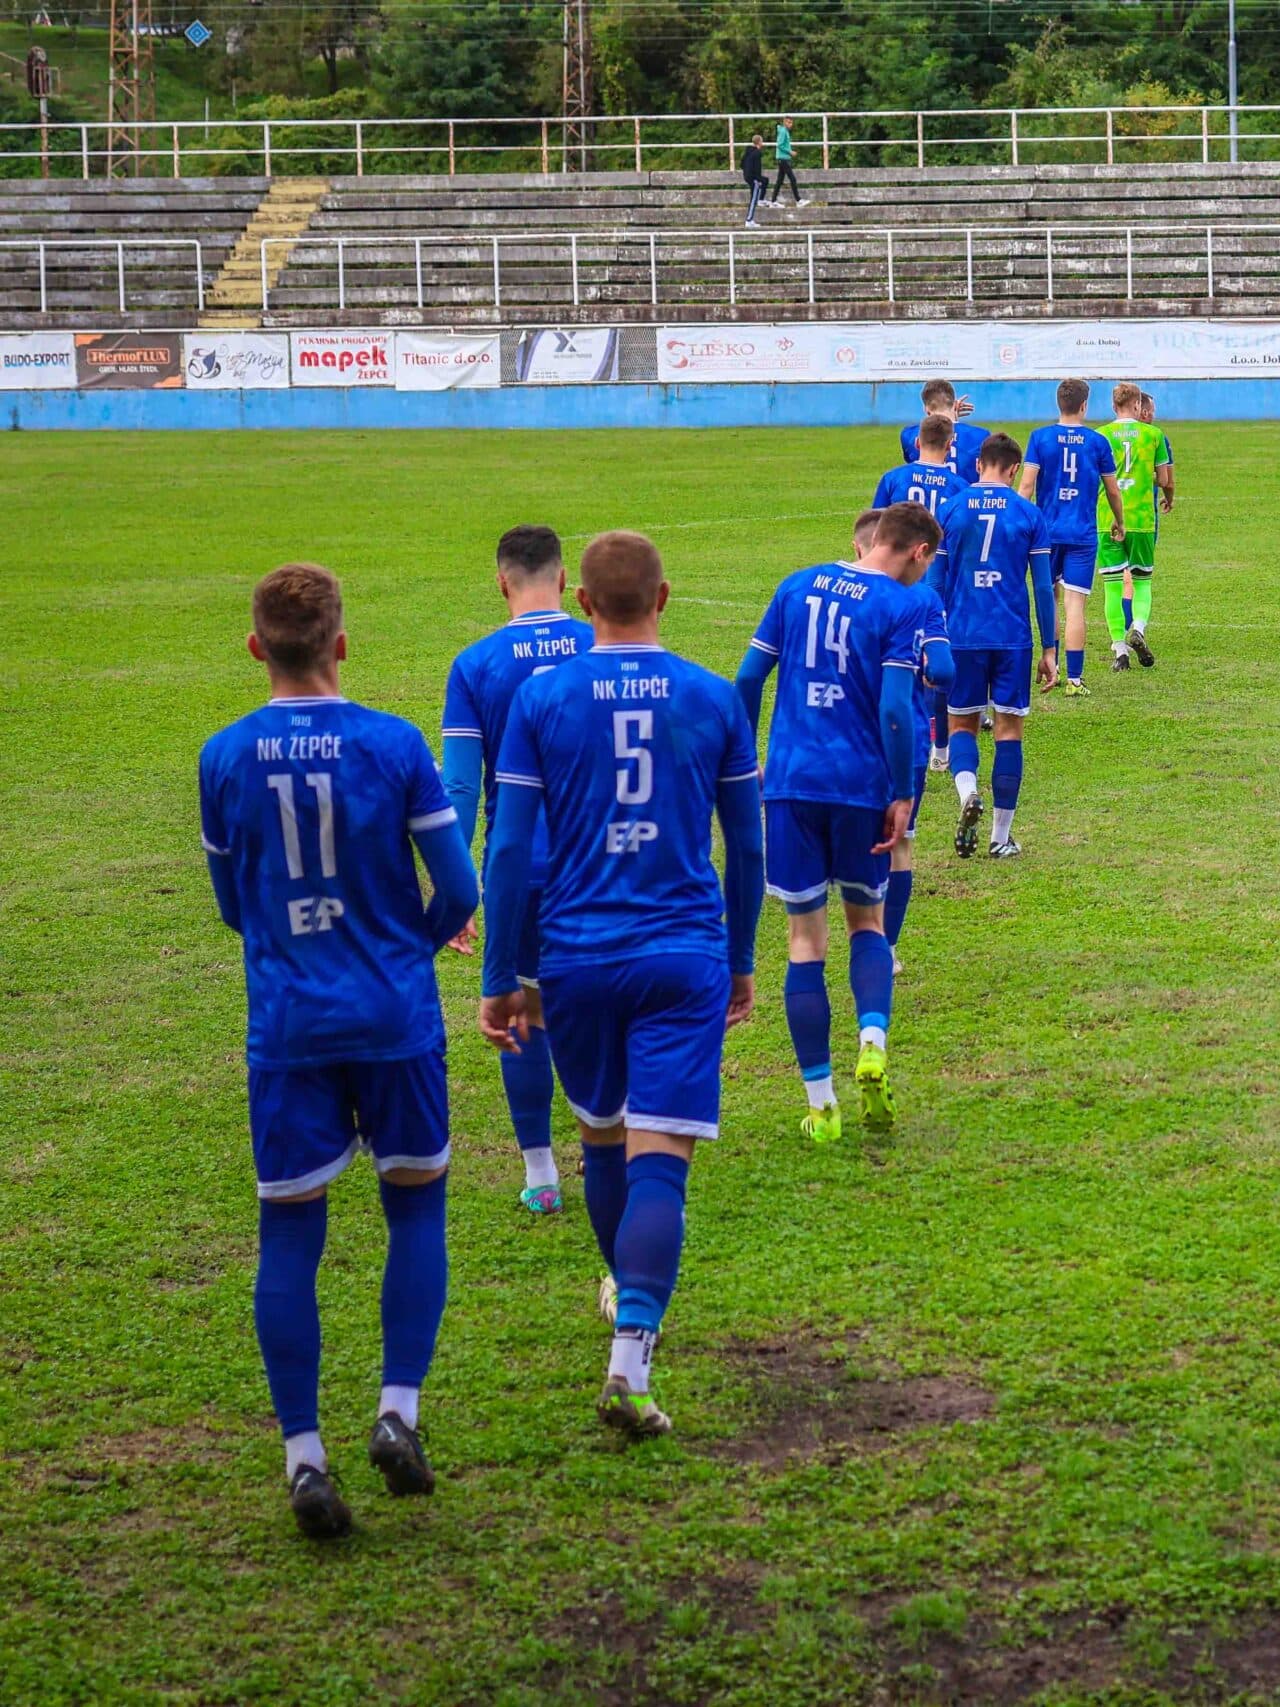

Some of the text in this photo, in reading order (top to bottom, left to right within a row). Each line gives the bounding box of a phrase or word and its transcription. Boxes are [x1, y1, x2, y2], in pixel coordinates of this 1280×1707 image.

[4, 353, 70, 368] BUDO-EXPORT
[300, 345, 388, 372] mapek
[402, 350, 494, 366] Titanic d.o.o.
[1063, 447, 1078, 483] 4
[1122, 441, 1131, 473] 1
[968, 498, 980, 509] NK
[978, 514, 996, 562] 7
[813, 574, 868, 601] NK ŽEPČE
[512, 636, 577, 659] NK ŽEPČE
[805, 595, 851, 674] 14
[593, 675, 669, 701] NK ŽEPČE
[257, 732, 342, 761] NK ŽEPČE
[613, 709, 653, 805] 5
[267, 773, 337, 880] 11
